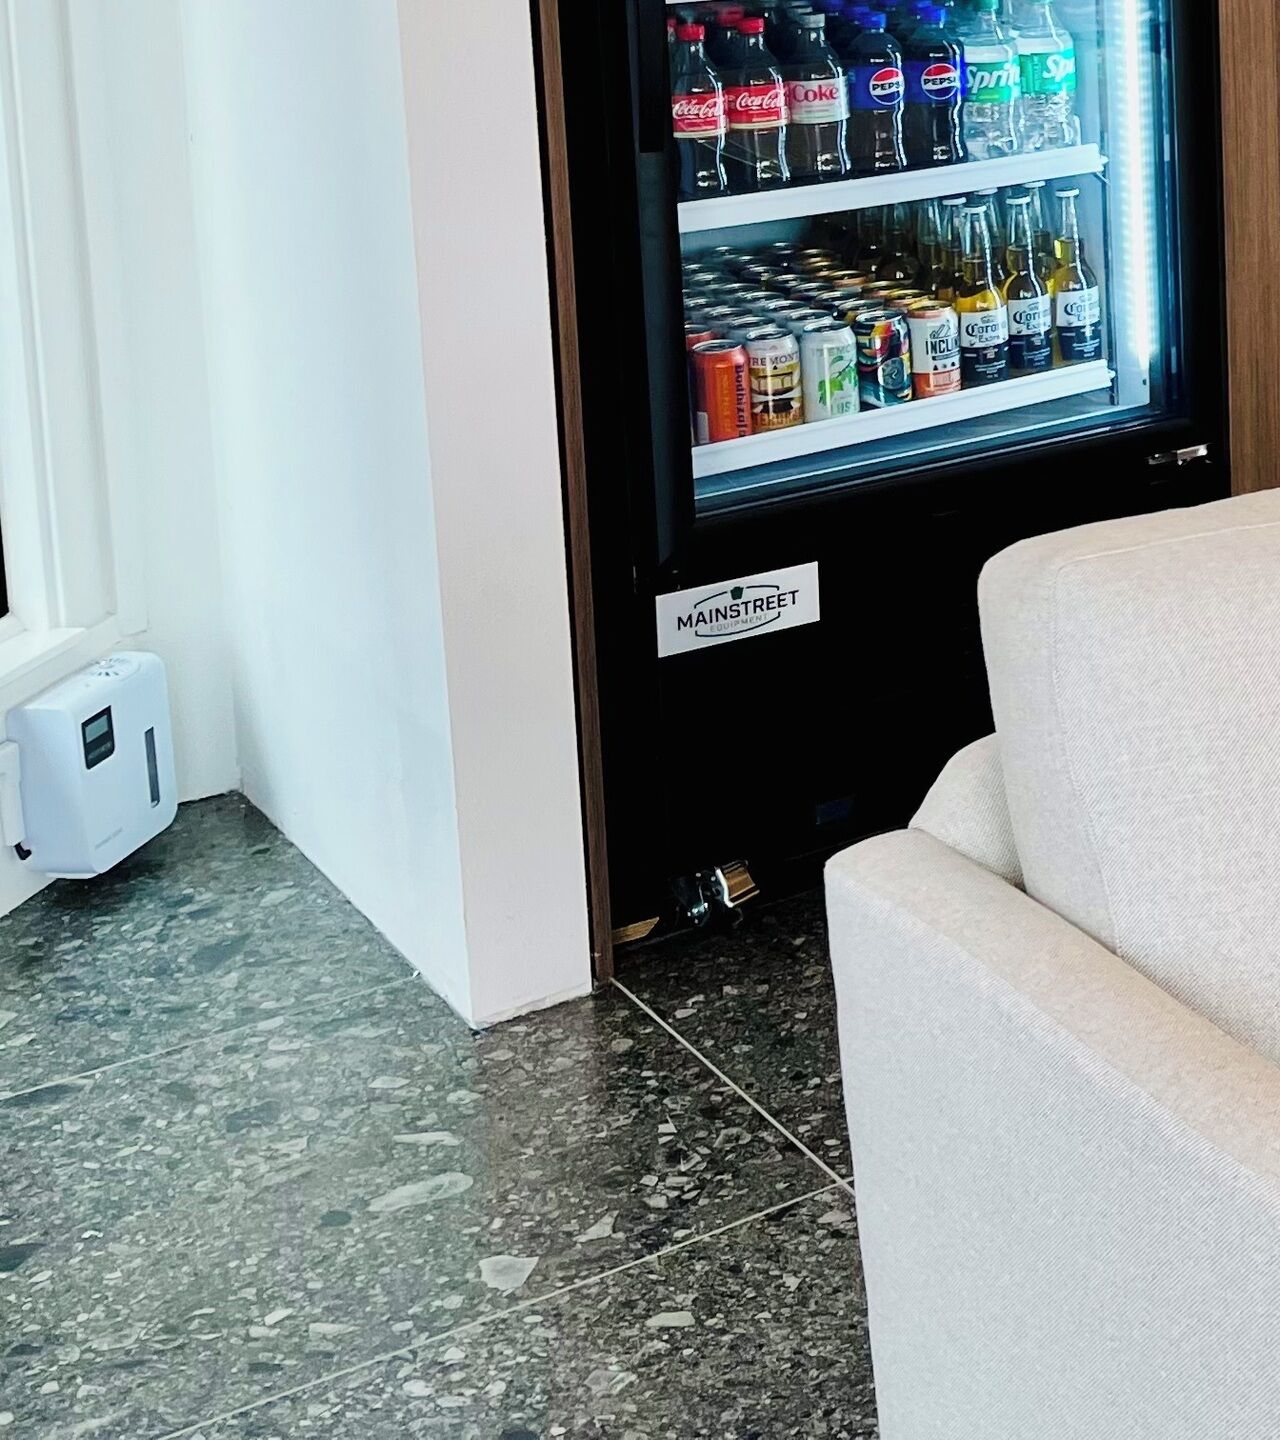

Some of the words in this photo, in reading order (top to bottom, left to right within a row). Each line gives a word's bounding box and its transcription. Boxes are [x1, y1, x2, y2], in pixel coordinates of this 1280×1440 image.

[871, 81, 900, 92] PEPS
[923, 76, 957, 86] PEPSI
[793, 82, 840, 103] Coke
[925, 337, 960, 356] INCLIN
[735, 364, 746, 437] Bodhizafa
[677, 590, 800, 631] MAINSTREET
[709, 614, 769, 633] EQUIPMENT
